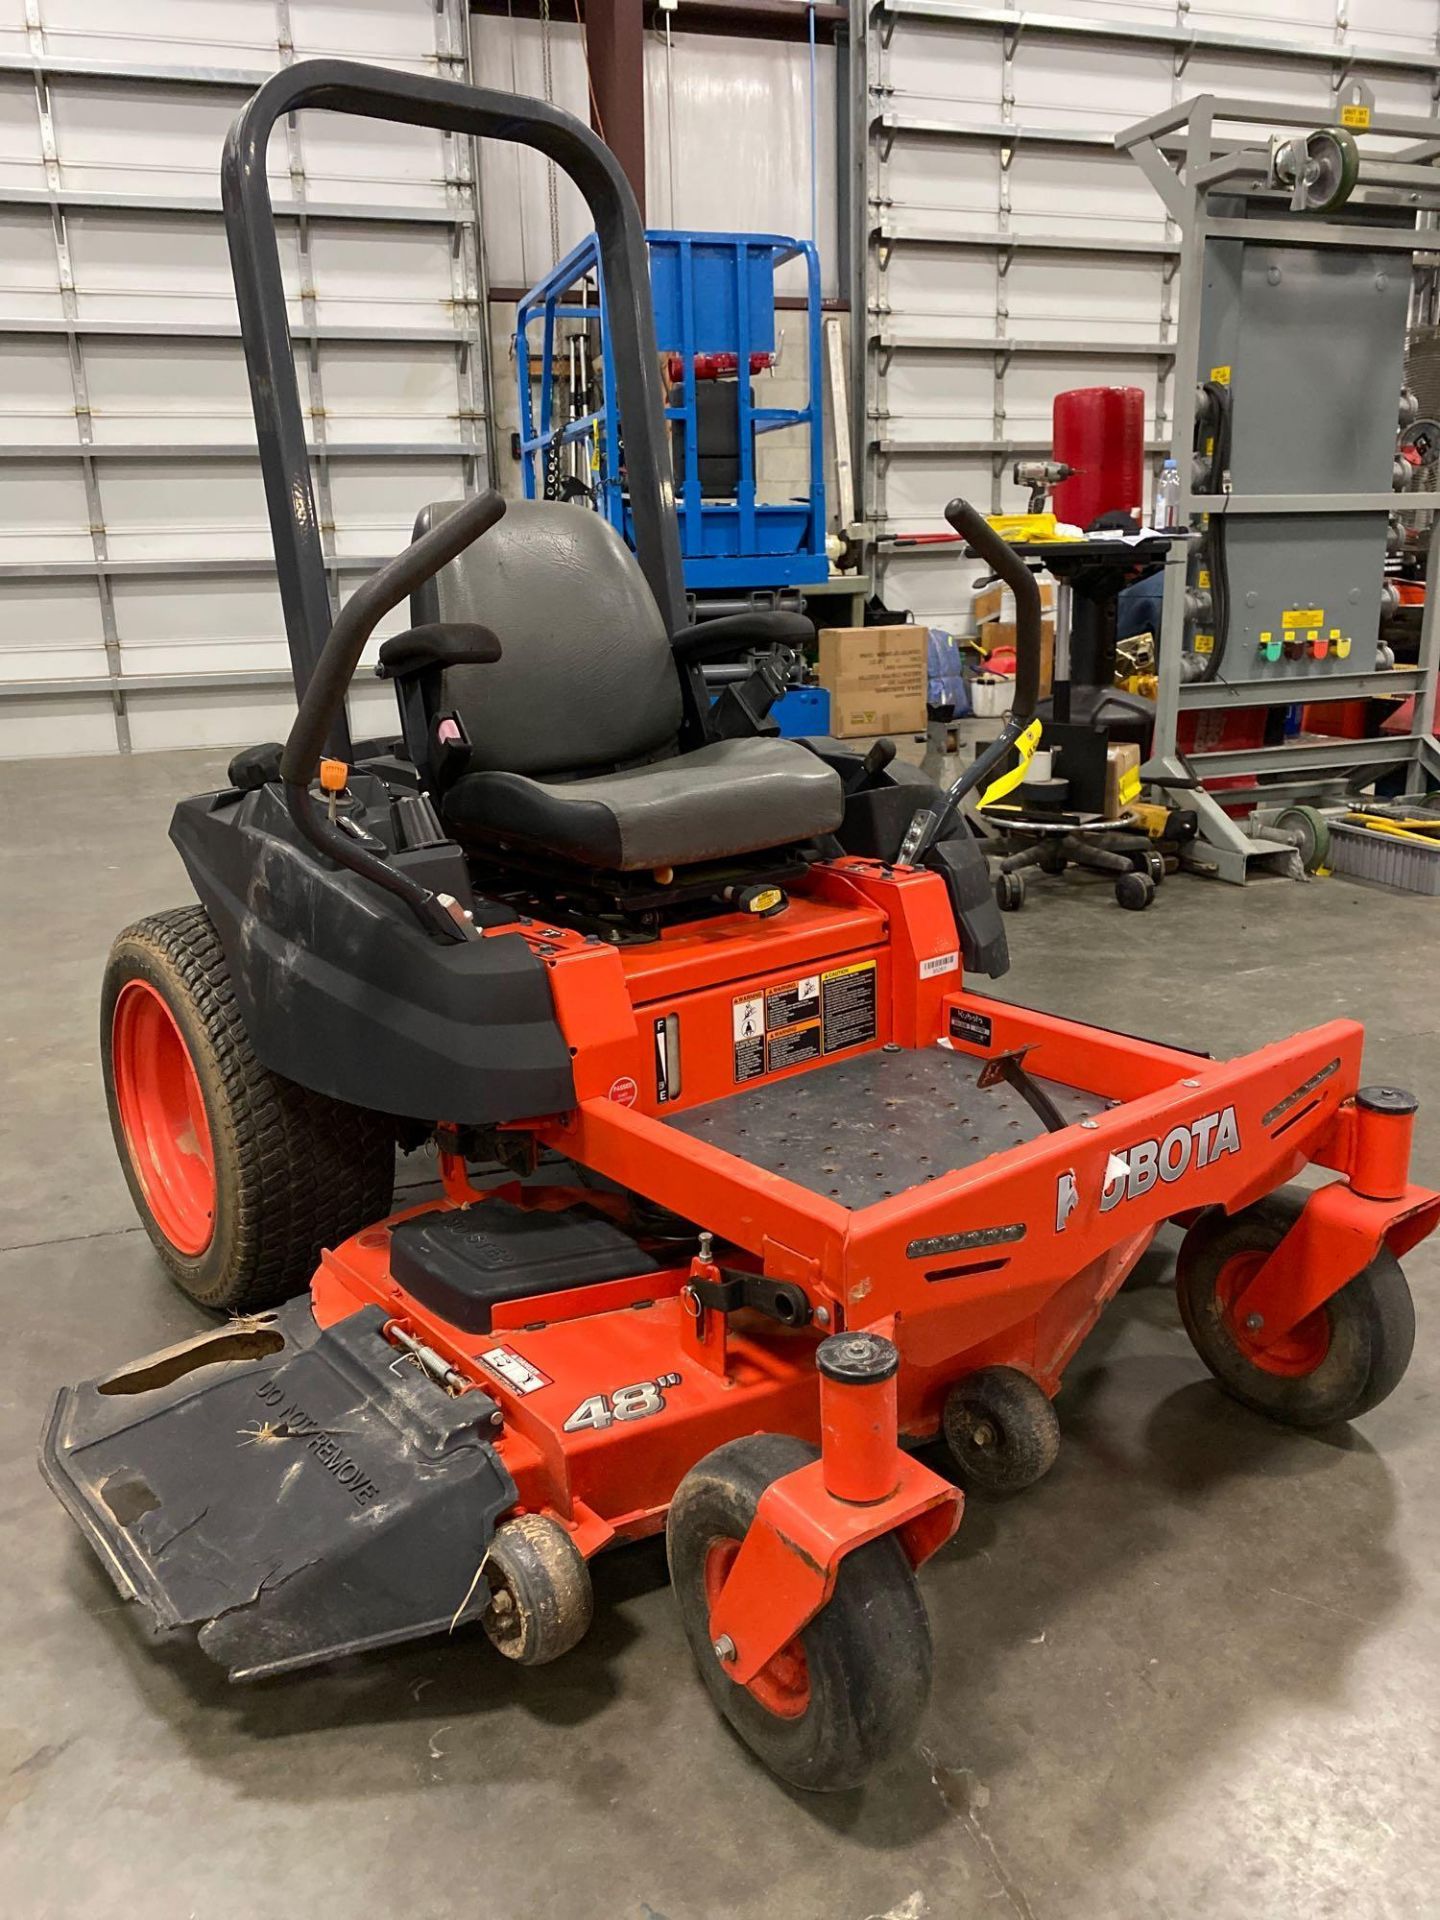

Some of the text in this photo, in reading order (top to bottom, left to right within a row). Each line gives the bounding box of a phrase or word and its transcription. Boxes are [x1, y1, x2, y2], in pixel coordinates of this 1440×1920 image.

[828, 968, 849, 978] CAUTION
[773, 983, 797, 994] WARNING
[738, 992, 762, 1002] WARNING
[657, 1020, 664, 1031] F
[774, 1026, 797, 1036] WARNING
[660, 1090, 667, 1100] E
[255, 1381, 284, 1406] DO
[563, 1372, 682, 1433] 48"
[307, 1431, 379, 1506] REMOVE
